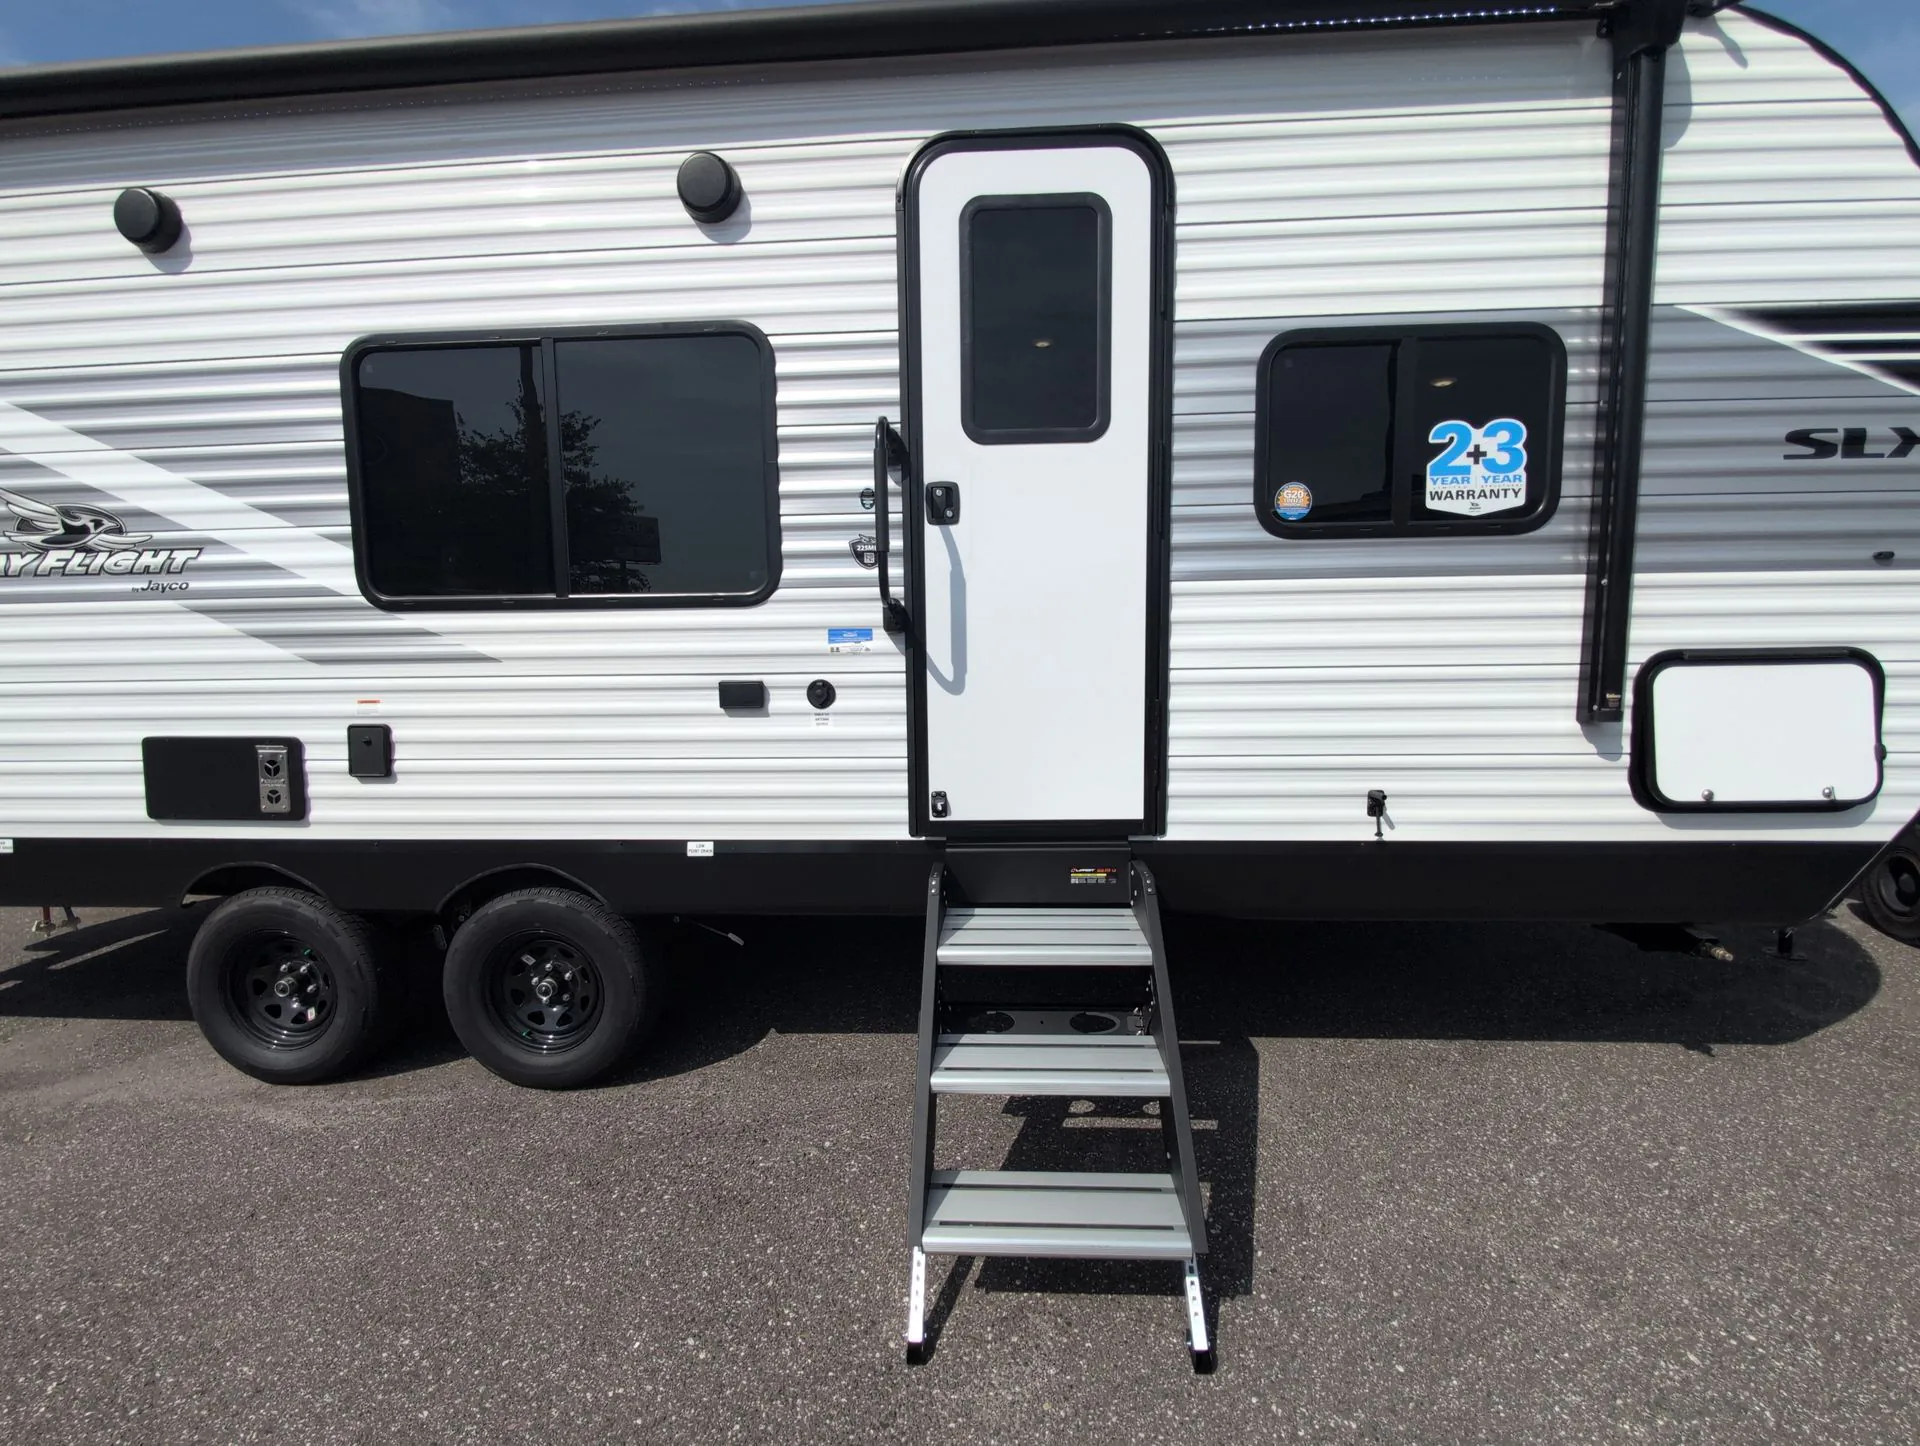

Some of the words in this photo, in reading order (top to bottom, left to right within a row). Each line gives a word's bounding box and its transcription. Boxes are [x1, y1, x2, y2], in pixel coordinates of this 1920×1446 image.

[1430, 476, 1471, 486] YEAR
[1481, 474, 1523, 484] YEAR
[1283, 490, 1304, 499] G20
[1429, 488, 1522, 501] WARRANTY
[34, 547, 204, 577] FLIGHT
[140, 580, 190, 593] Jayco
